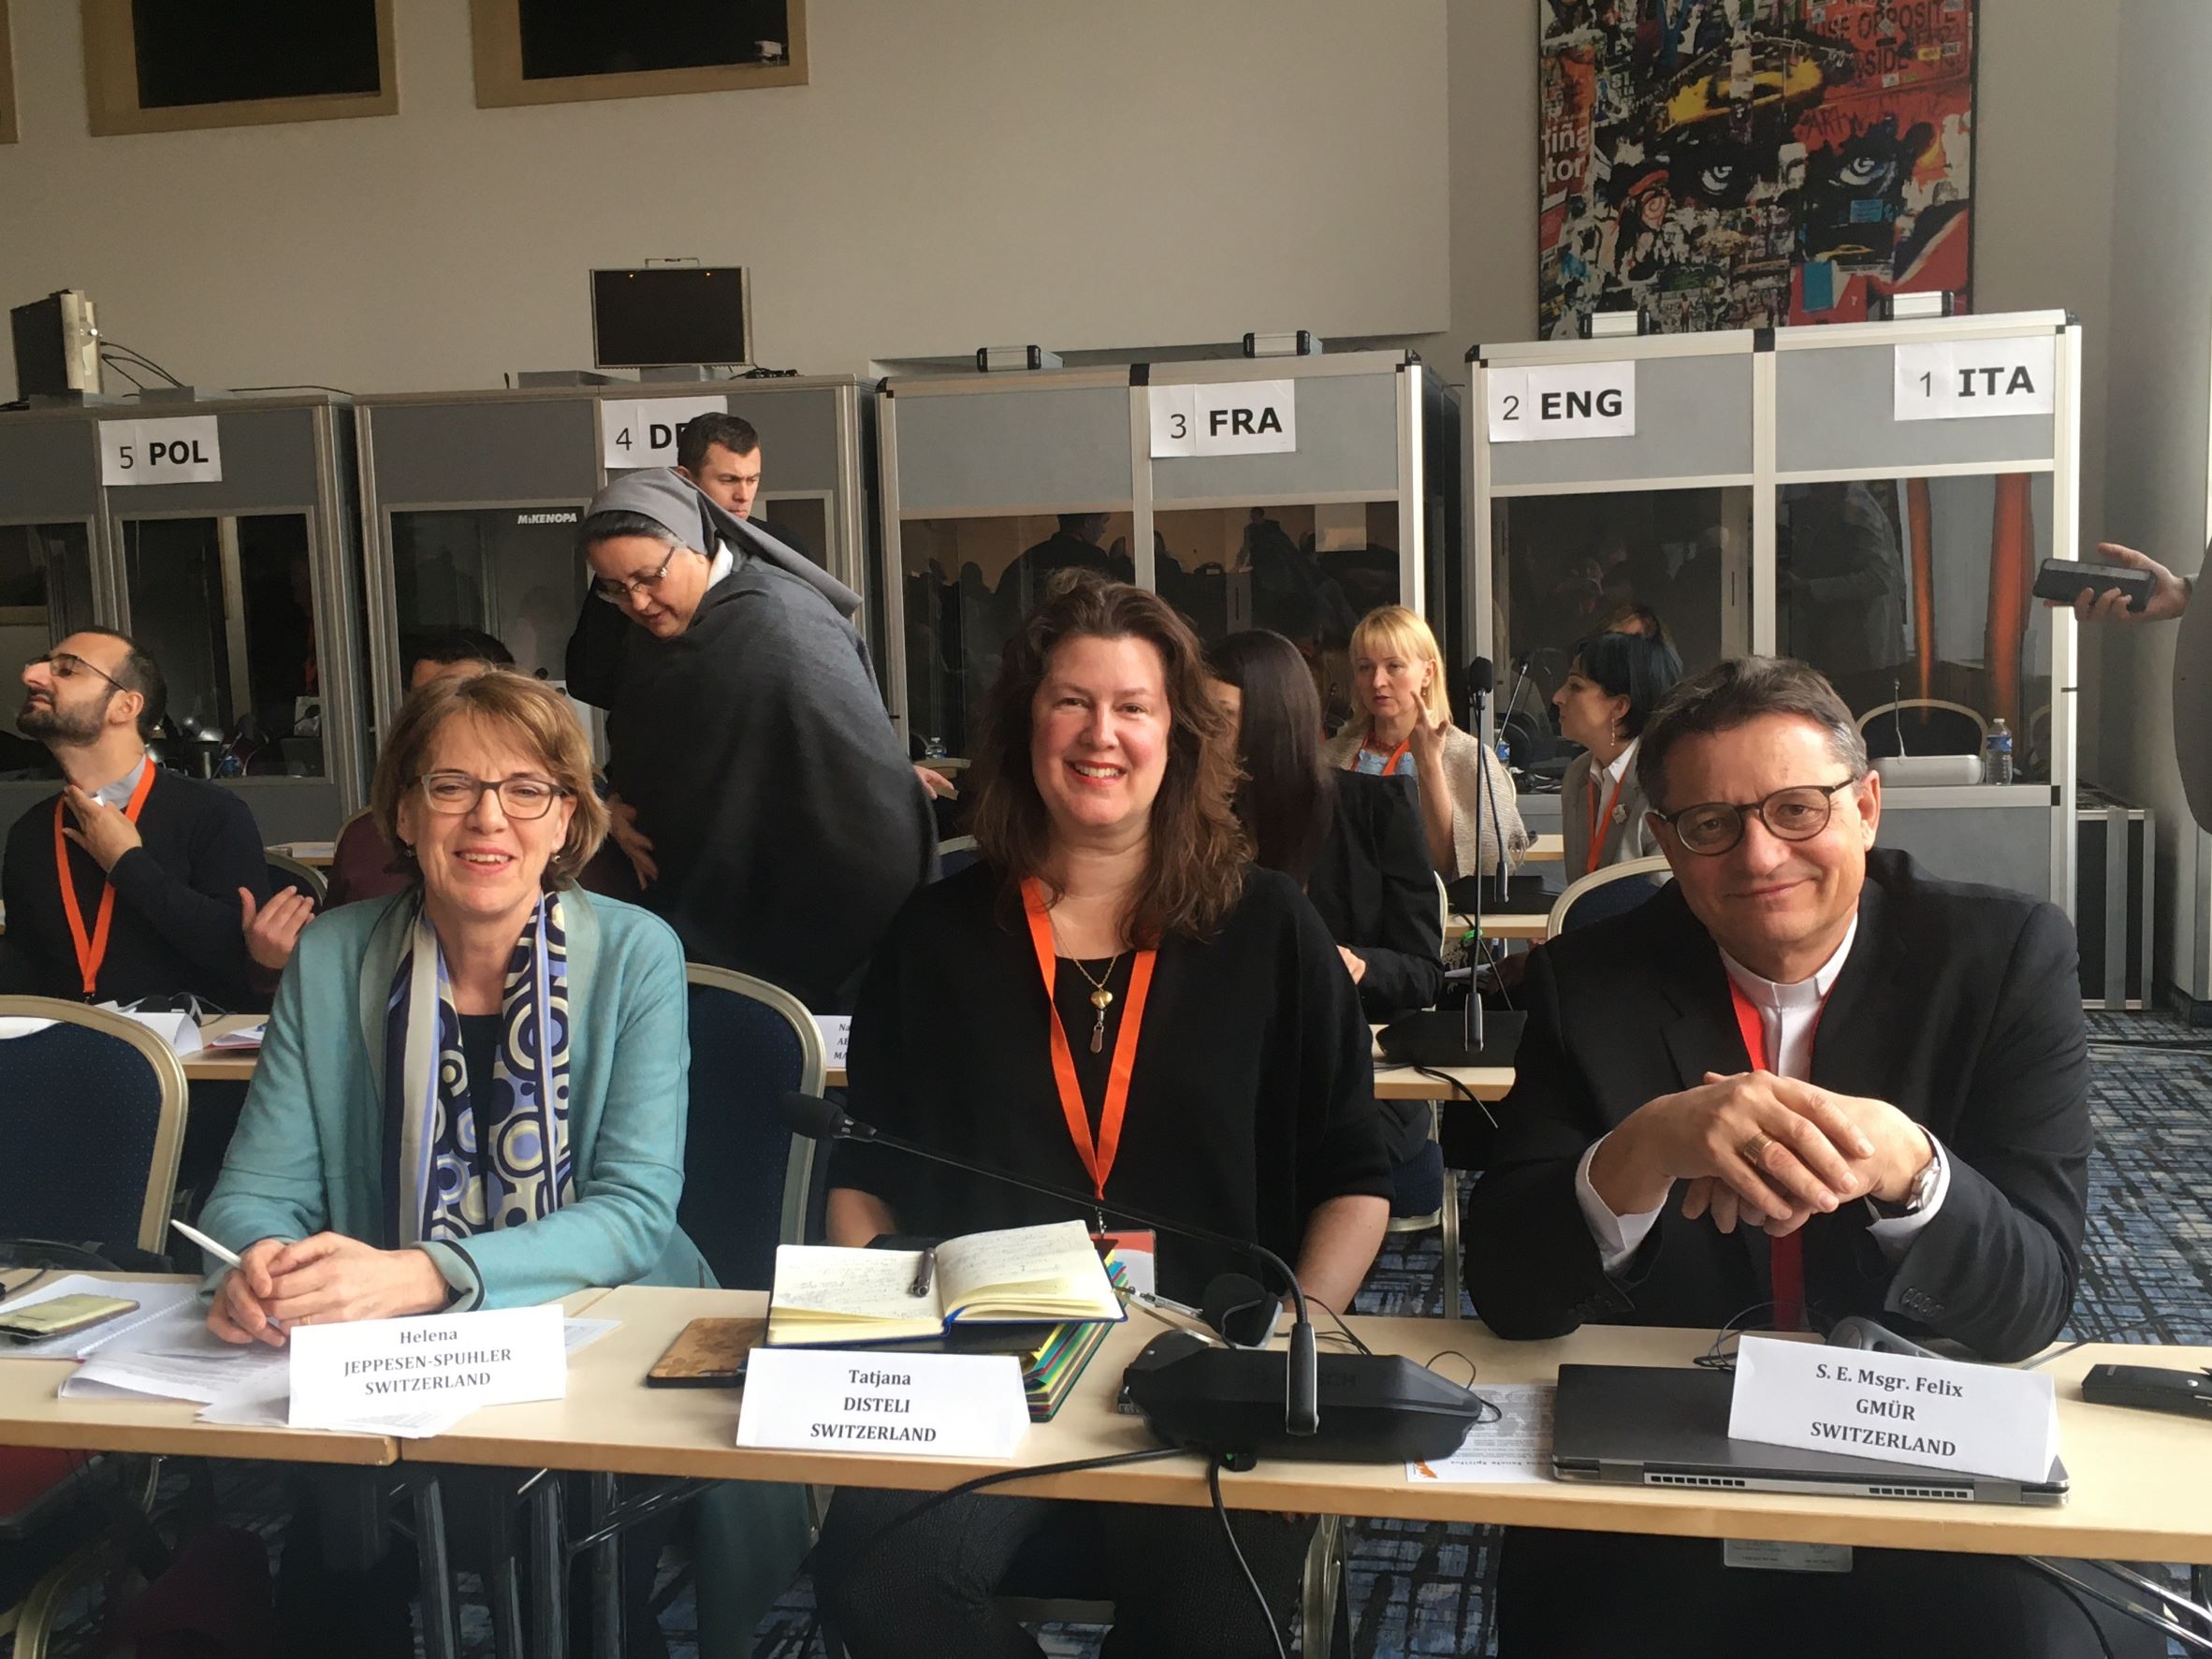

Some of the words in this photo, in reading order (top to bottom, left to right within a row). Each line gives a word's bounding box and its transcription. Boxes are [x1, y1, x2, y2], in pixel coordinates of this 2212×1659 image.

[1920, 371, 1931, 398] 1
[1957, 366, 2035, 397] ITA
[1503, 395, 1520, 420] 2
[1541, 388, 1623, 420] ENG
[1171, 414, 1186, 439] 3
[1210, 407, 1283, 436] FRA
[616, 428, 633, 451] 4
[120, 445, 134, 469] 5
[150, 440, 209, 466] POL
[400, 1330, 458, 1345] Helena
[344, 1348, 512, 1377] JEPPESEN-SPUHLER
[365, 1373, 491, 1395] SWITZERLAND
[849, 1369, 911, 1388] Tatjana
[1816, 1363, 1831, 1379] S.
[1837, 1366, 1853, 1382] E.
[1857, 1369, 1910, 1392] Msgr.
[1915, 1376, 1963, 1397] Felix
[843, 1397, 910, 1413] DISTELI
[1856, 1398, 1915, 1421] GMÜR
[810, 1423, 937, 1442] SWITZERLAND
[1811, 1421, 1956, 1457] SWITZERLAND
